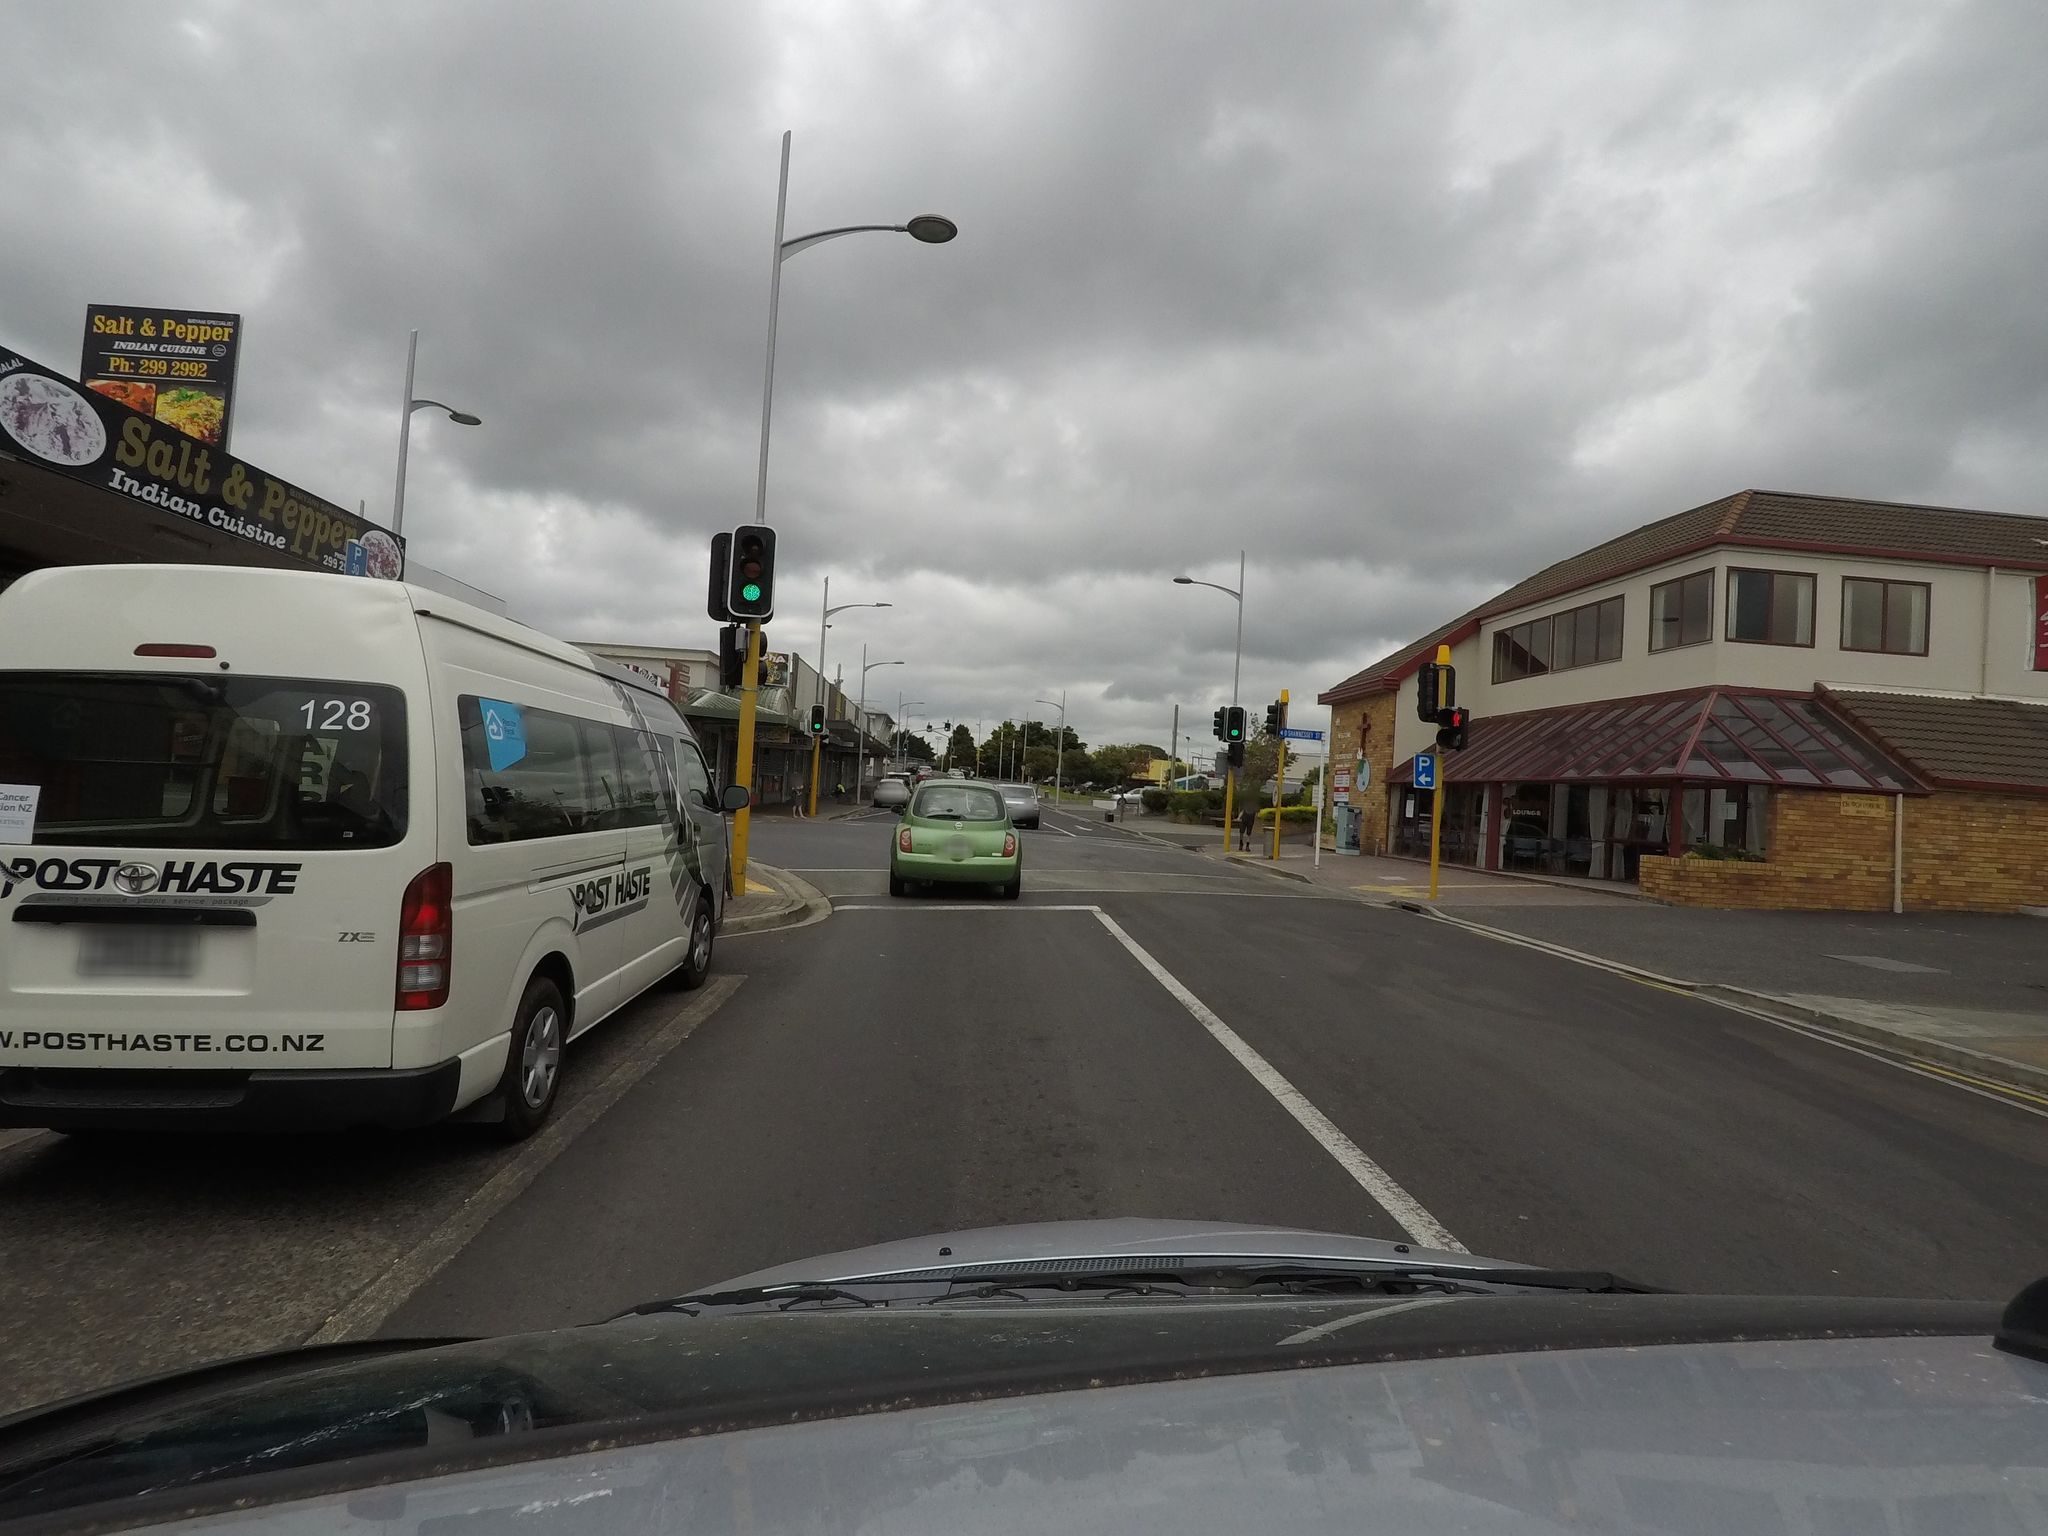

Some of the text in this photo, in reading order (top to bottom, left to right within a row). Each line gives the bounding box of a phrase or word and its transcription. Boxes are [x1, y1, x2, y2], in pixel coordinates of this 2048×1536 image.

[93, 315, 234, 343] Salt & Pepper
[113, 341, 207, 355] INDIAN CUISINE
[0, 357, 24, 373] ALAL
[108, 357, 208, 377] Ph: 299 2992
[115, 417, 358, 561] Salt & Pepper
[108, 467, 286, 549] Indian Cuisine
[323, 554, 338, 569] 299
[355, 546, 362, 560] P
[300, 699, 370, 730] 128
[1418, 757, 1430, 771] P
[18, 804, 33, 812] NZ
[0, 858, 302, 898] POST HASTE
[572, 866, 650, 932] POST HASTE
